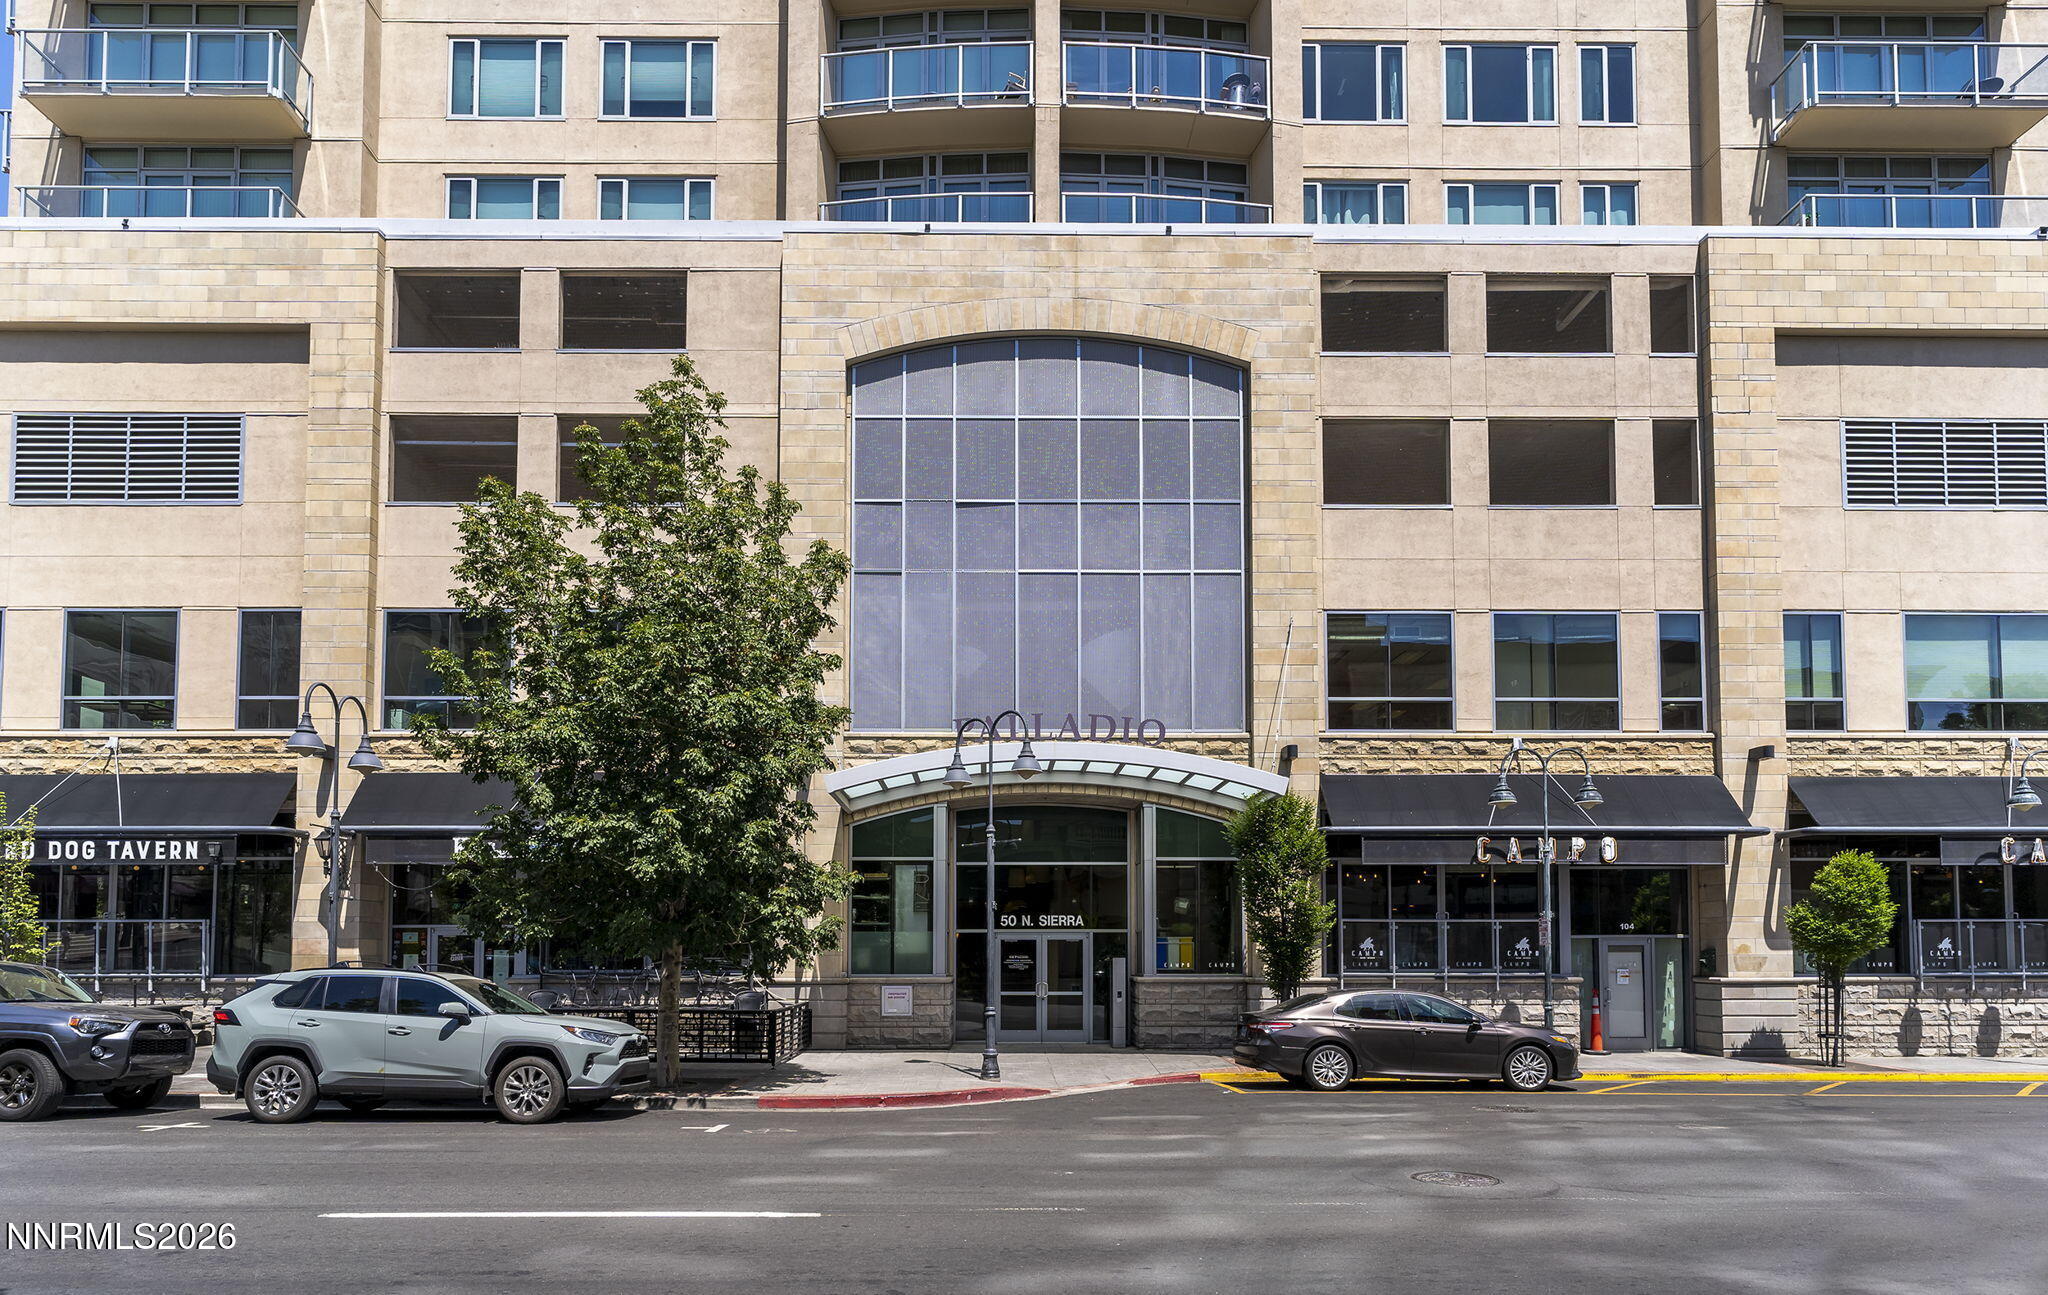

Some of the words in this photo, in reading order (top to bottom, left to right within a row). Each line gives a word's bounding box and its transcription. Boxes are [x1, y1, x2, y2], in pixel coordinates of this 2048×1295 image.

[953, 713, 1166, 746] PALLADIO
[48, 841, 96, 860] DOG
[107, 841, 199, 860] TAVERN
[1477, 836, 1618, 863] CAMPO
[1000, 915, 1017, 927] 50
[1021, 915, 1034, 927] N.
[1038, 915, 1084, 927] SIERRA
